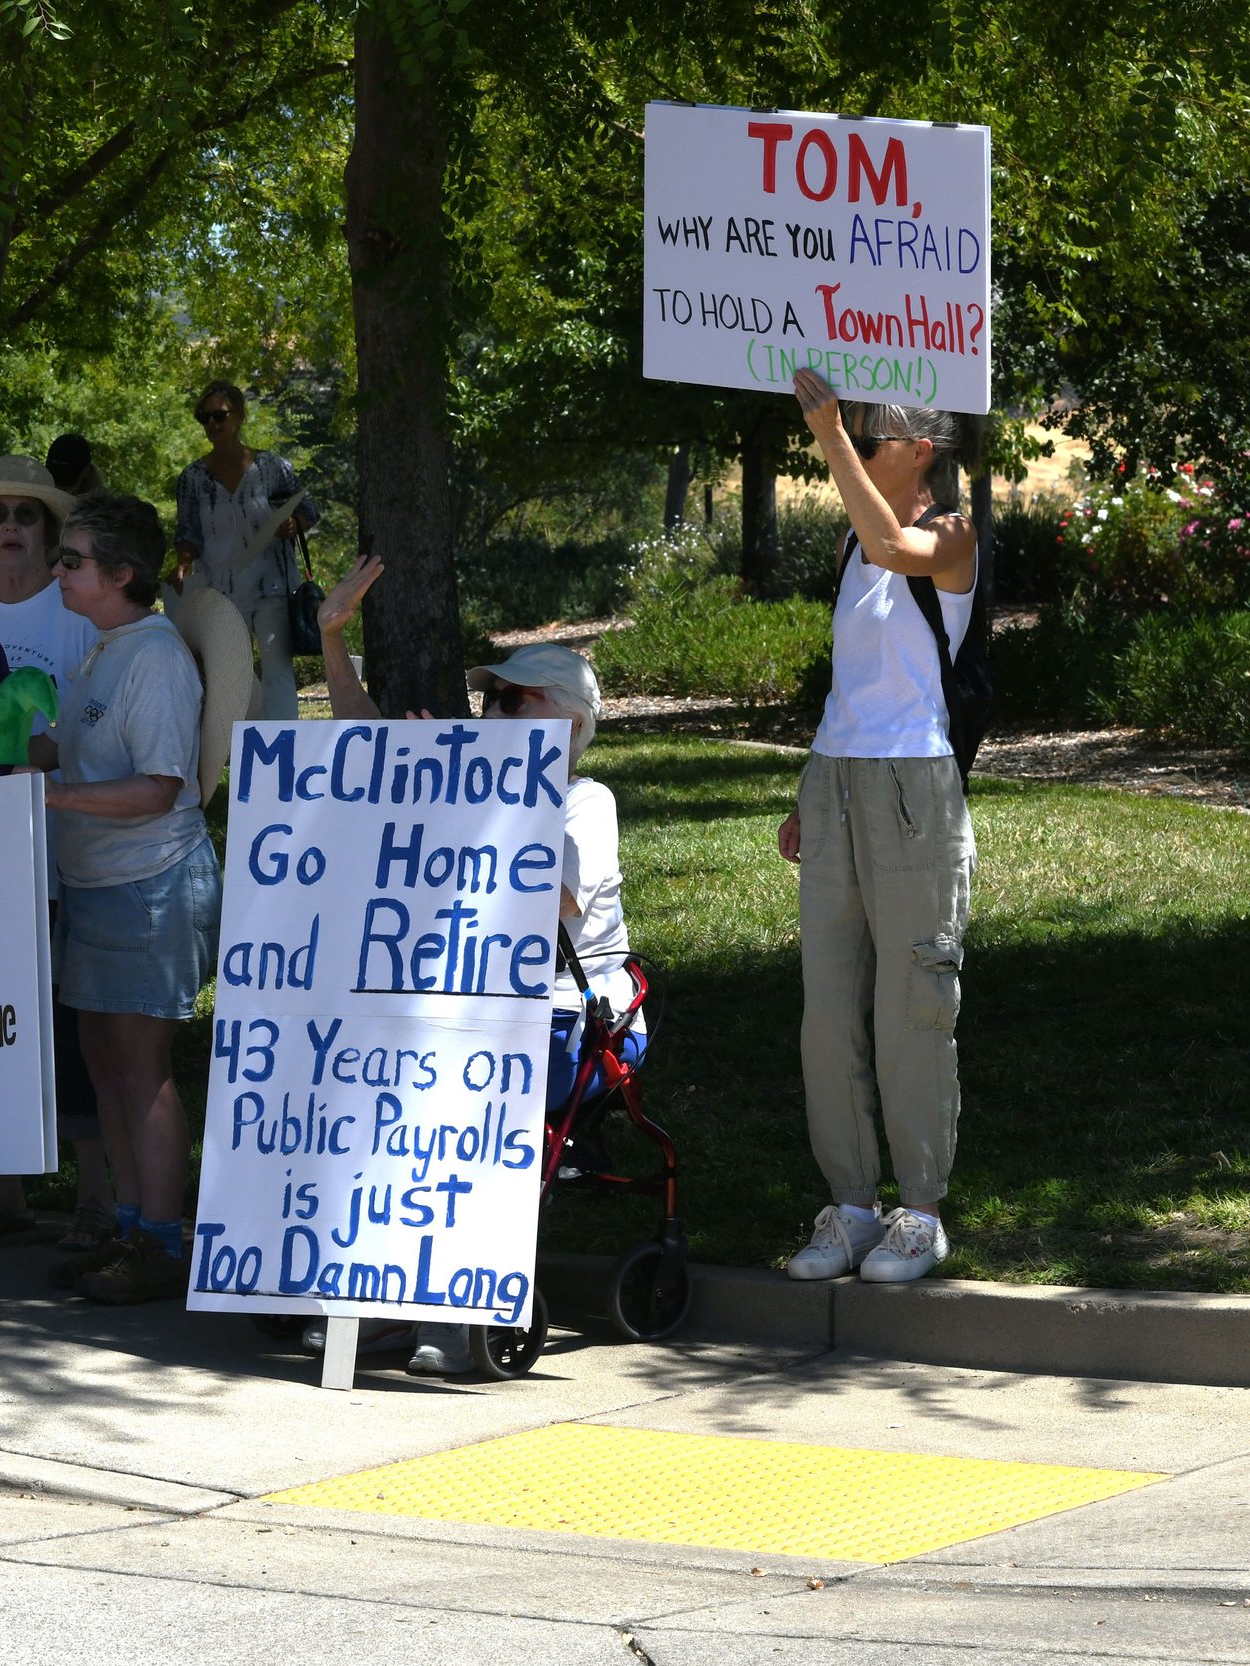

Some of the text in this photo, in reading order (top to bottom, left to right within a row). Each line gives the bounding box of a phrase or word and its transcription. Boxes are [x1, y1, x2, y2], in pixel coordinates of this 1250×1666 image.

[747, 121, 922, 219] TOM,
[658, 213, 980, 274] WHY ARE YOU AFRAID
[652, 282, 984, 356] TO HOLD A Town Hall?
[746, 339, 938, 405] (IN PERSON!)
[4, 643, 56, 667] DVENTURE
[236, 723, 564, 809] McClintock
[248, 821, 557, 895] Go Home
[222, 897, 551, 996] and Retire
[214, 1017, 534, 1095] 43 Years on
[230, 1091, 536, 1183] Public Payrolls
[282, 1168, 474, 1249] is just
[196, 1223, 530, 1325] Too Damn Long
